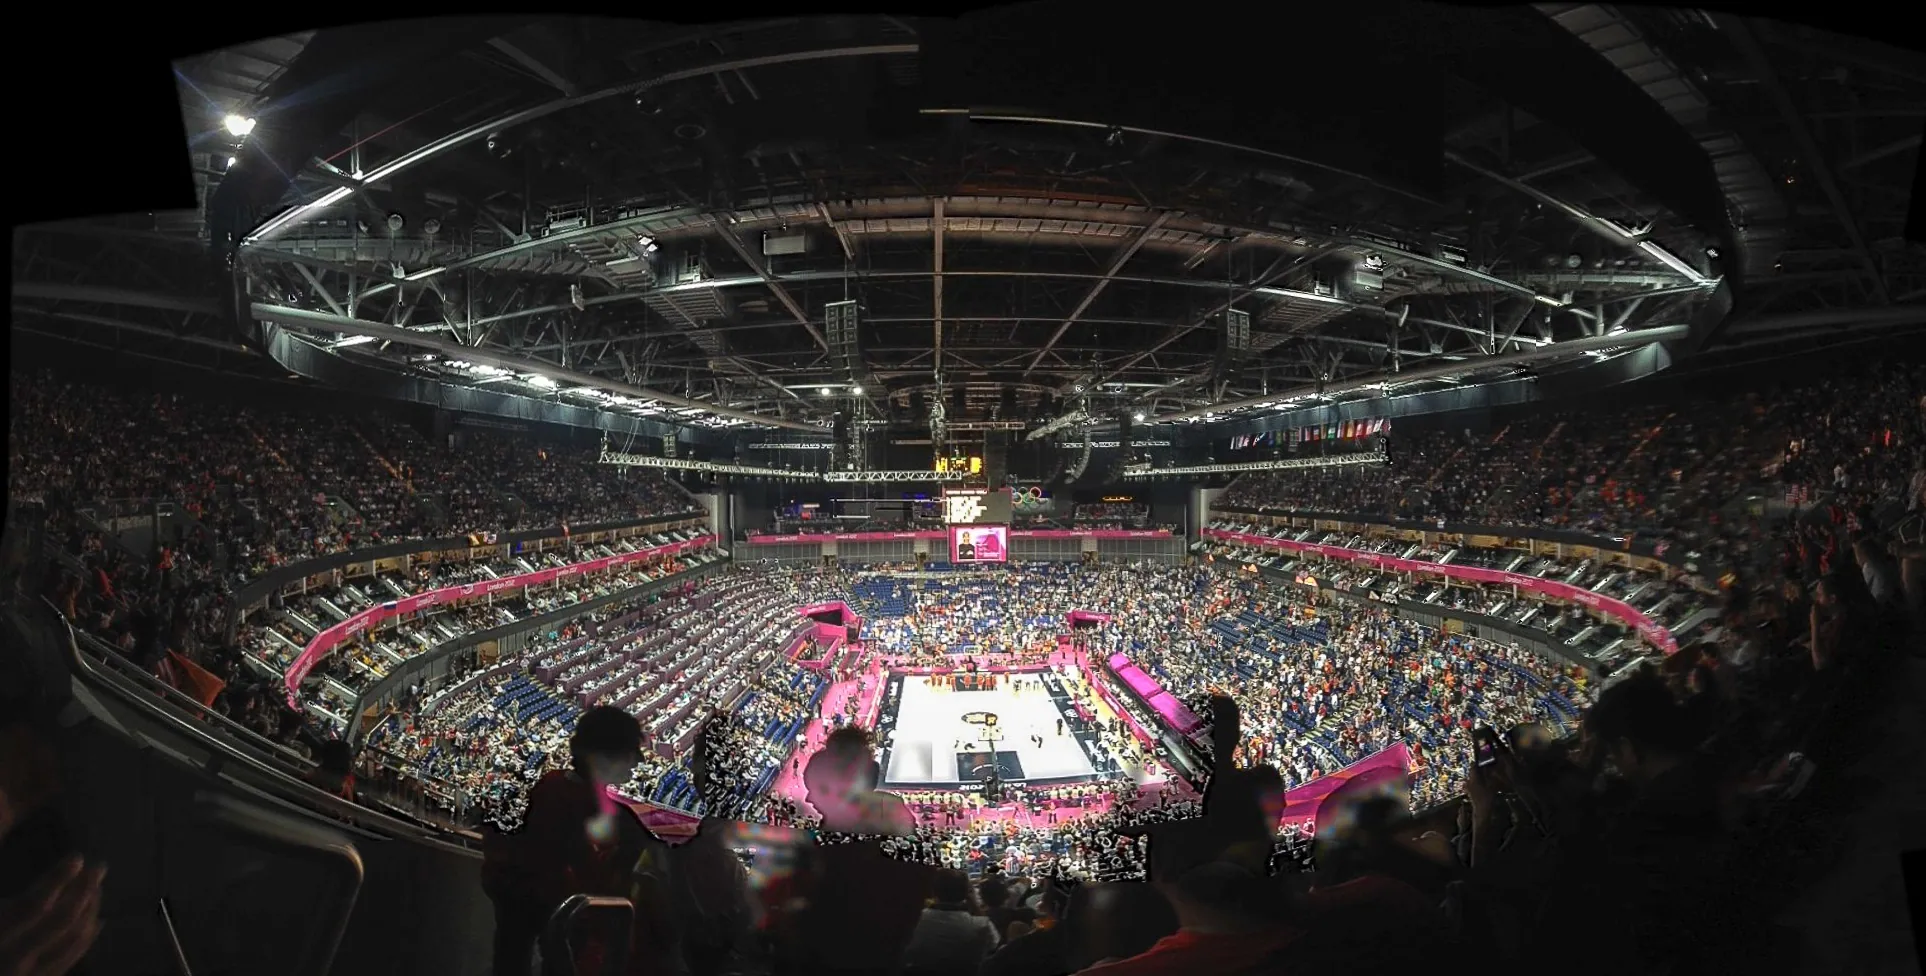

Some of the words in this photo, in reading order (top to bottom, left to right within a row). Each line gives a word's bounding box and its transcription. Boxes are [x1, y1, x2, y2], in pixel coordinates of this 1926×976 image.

[1417, 563, 1433, 572] London
[1433, 565, 1446, 573] 2012
[1505, 575, 1521, 584] London
[487, 581, 504, 592] London
[504, 579, 516, 588] 2012
[345, 621, 360, 635] London
